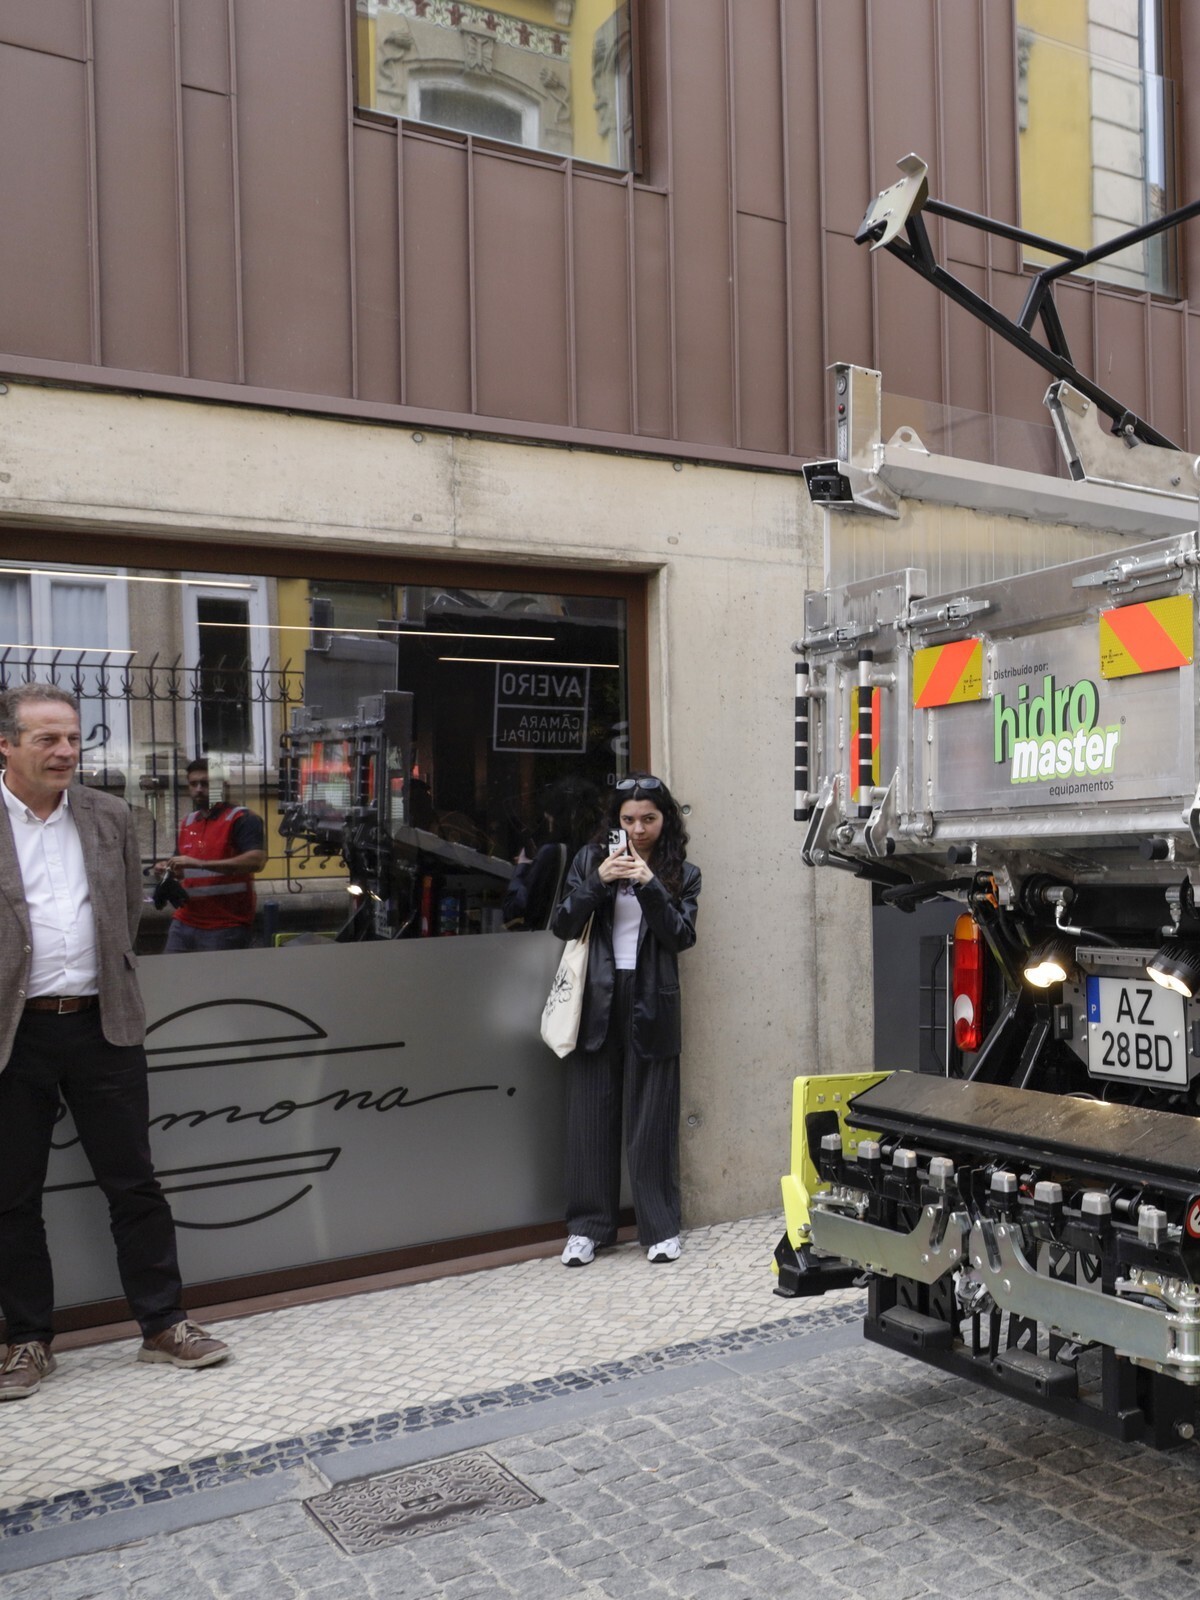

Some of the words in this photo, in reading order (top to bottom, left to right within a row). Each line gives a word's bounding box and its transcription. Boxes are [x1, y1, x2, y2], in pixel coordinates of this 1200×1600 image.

[994, 664, 1033, 680] Distribuído
[1034, 662, 1049, 675] por:
[994, 674, 1100, 764] hidro
[1011, 726, 1120, 782] master
[1049, 780, 1114, 797] equipamentos
[1091, 1004, 1097, 1014] P
[1116, 988, 1155, 1026] AZ
